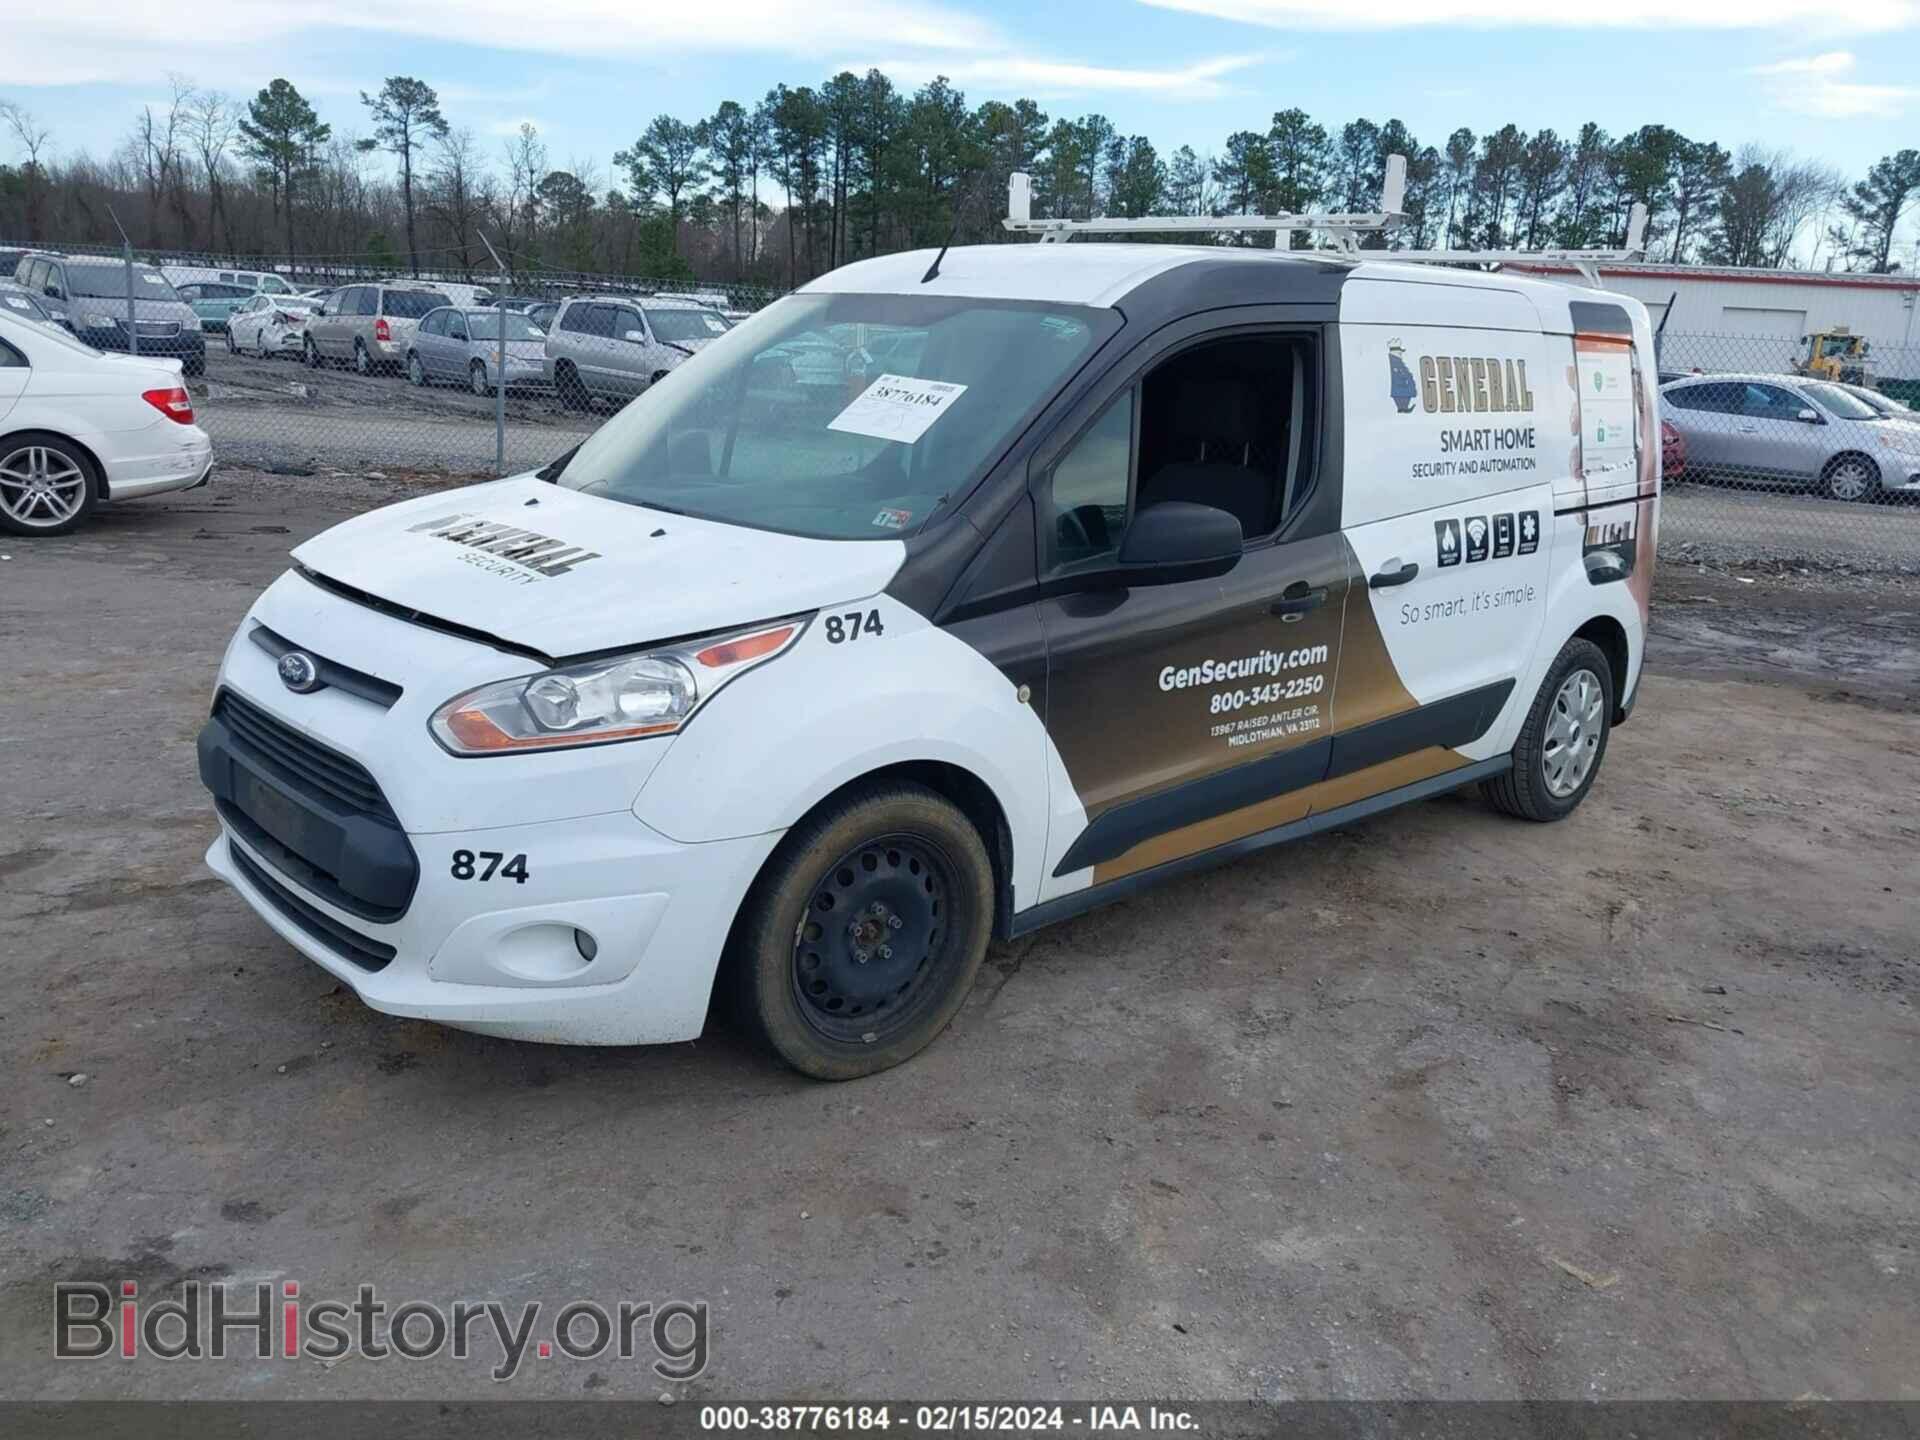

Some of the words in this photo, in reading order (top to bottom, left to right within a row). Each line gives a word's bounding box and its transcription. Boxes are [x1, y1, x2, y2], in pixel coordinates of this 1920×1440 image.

[1418, 355, 1534, 413] GENERAL
[1440, 429, 1491, 453] SMART
[1494, 427, 1536, 450] HOME
[1412, 461, 1456, 478] SECURITY
[1459, 459, 1479, 475] AND
[1480, 456, 1536, 473] AUTOMATION
[456, 551, 541, 585] SECURITY
[1400, 603, 1420, 625] So
[1424, 596, 1466, 621] smart,
[1471, 590, 1491, 611] it's
[1494, 583, 1536, 607] simple.
[825, 609, 884, 644] 874
[1158, 644, 1328, 691] GenSecurity.com
[1210, 674, 1324, 714] 800-343-2250
[1237, 715, 1269, 731] RAISED
[1270, 708, 1303, 724] ANTLER
[1286, 722, 1298, 735] VA
[451, 849, 530, 884] 874
